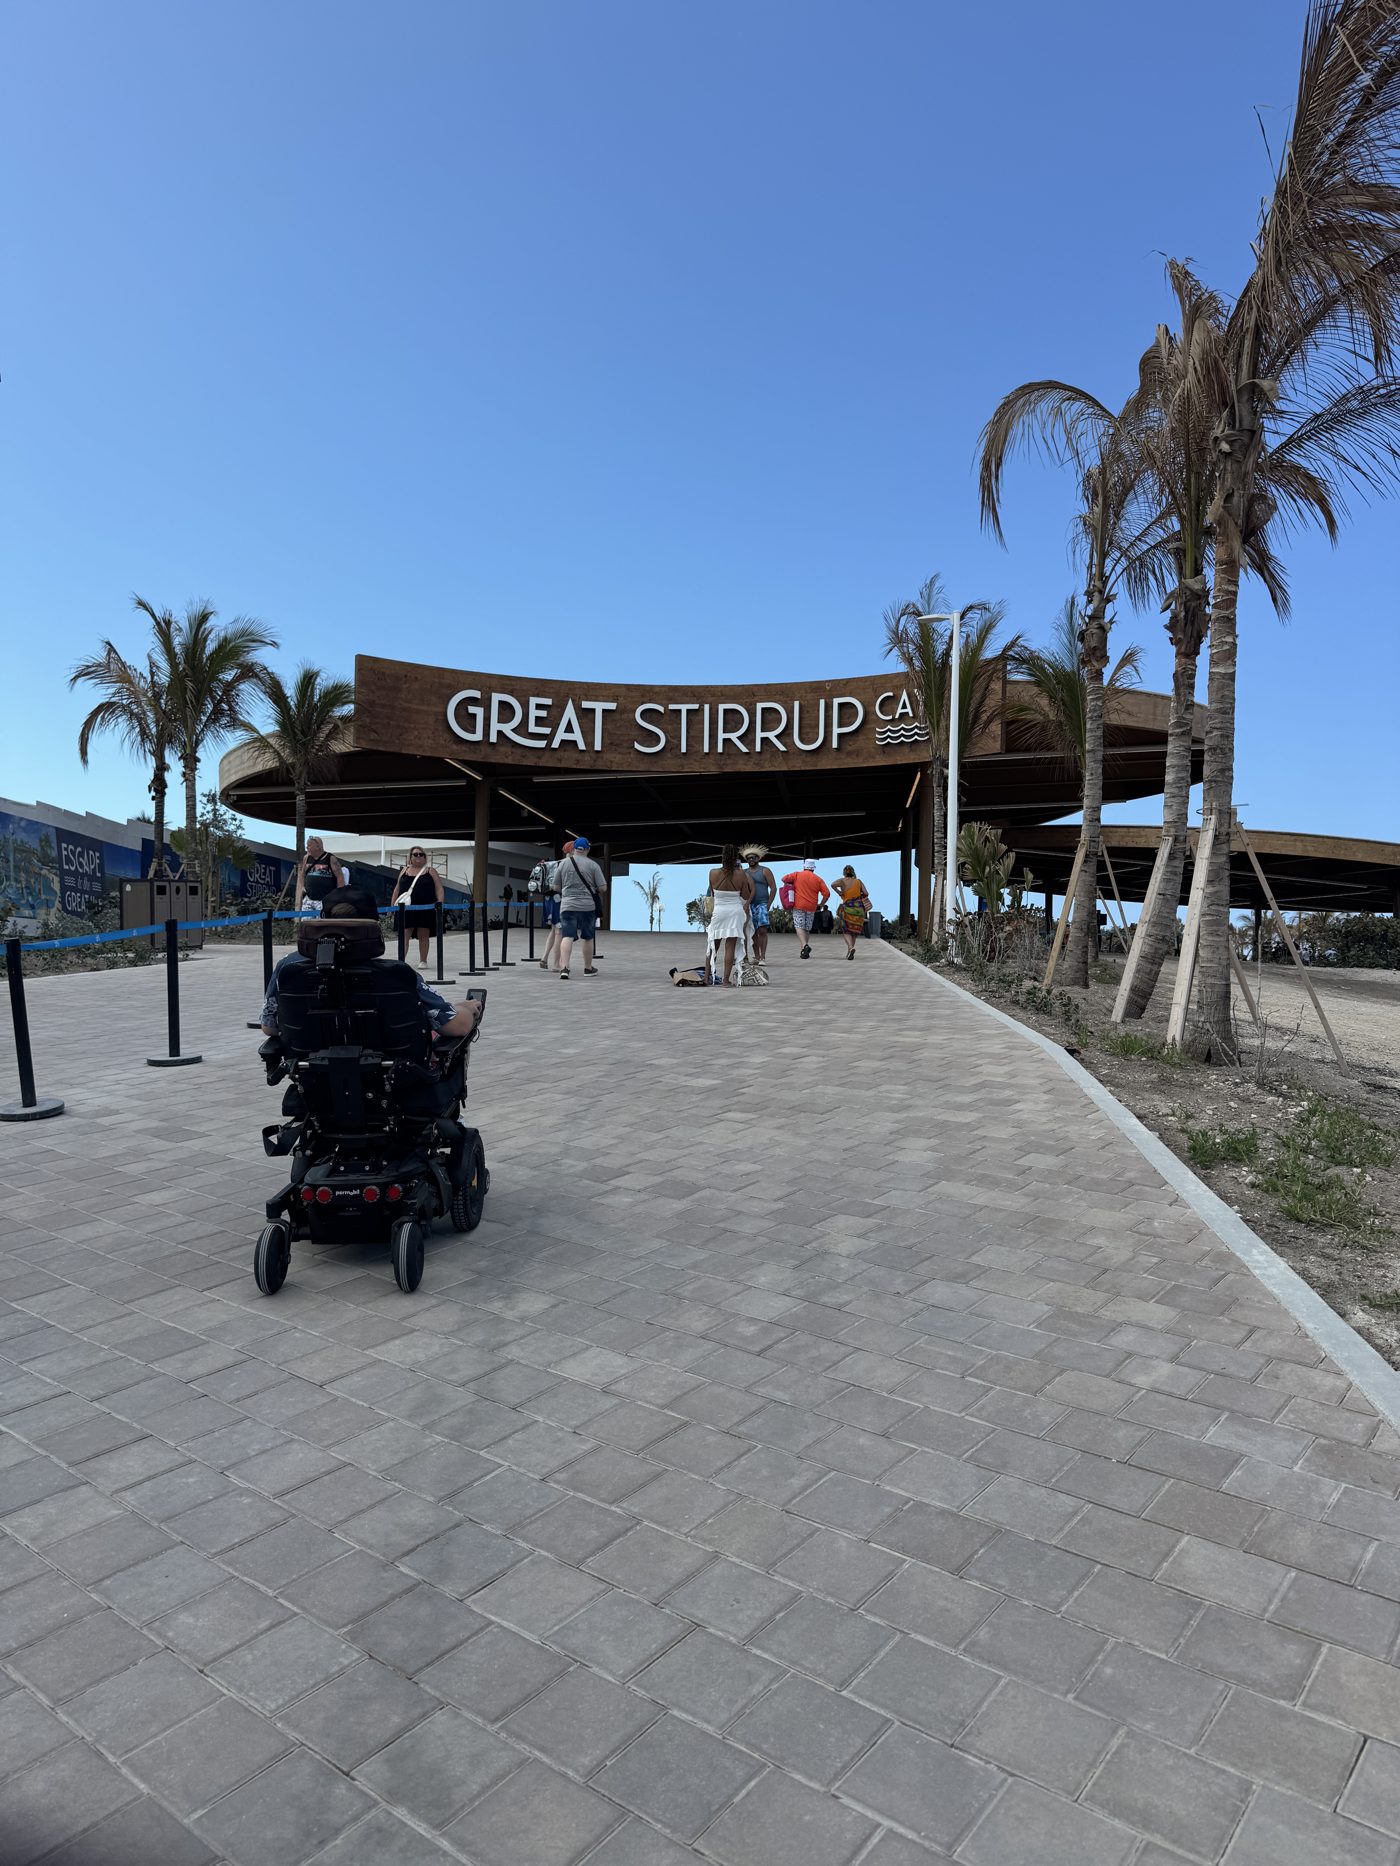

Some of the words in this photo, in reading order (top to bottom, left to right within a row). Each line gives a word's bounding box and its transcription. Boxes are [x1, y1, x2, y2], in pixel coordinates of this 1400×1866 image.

[446, 689, 618, 751] GREAT
[633, 696, 865, 753] STIRRUP
[875, 688, 923, 720] CA
[61, 843, 102, 877] ESCAPE
[247, 863, 276, 885] GREAT
